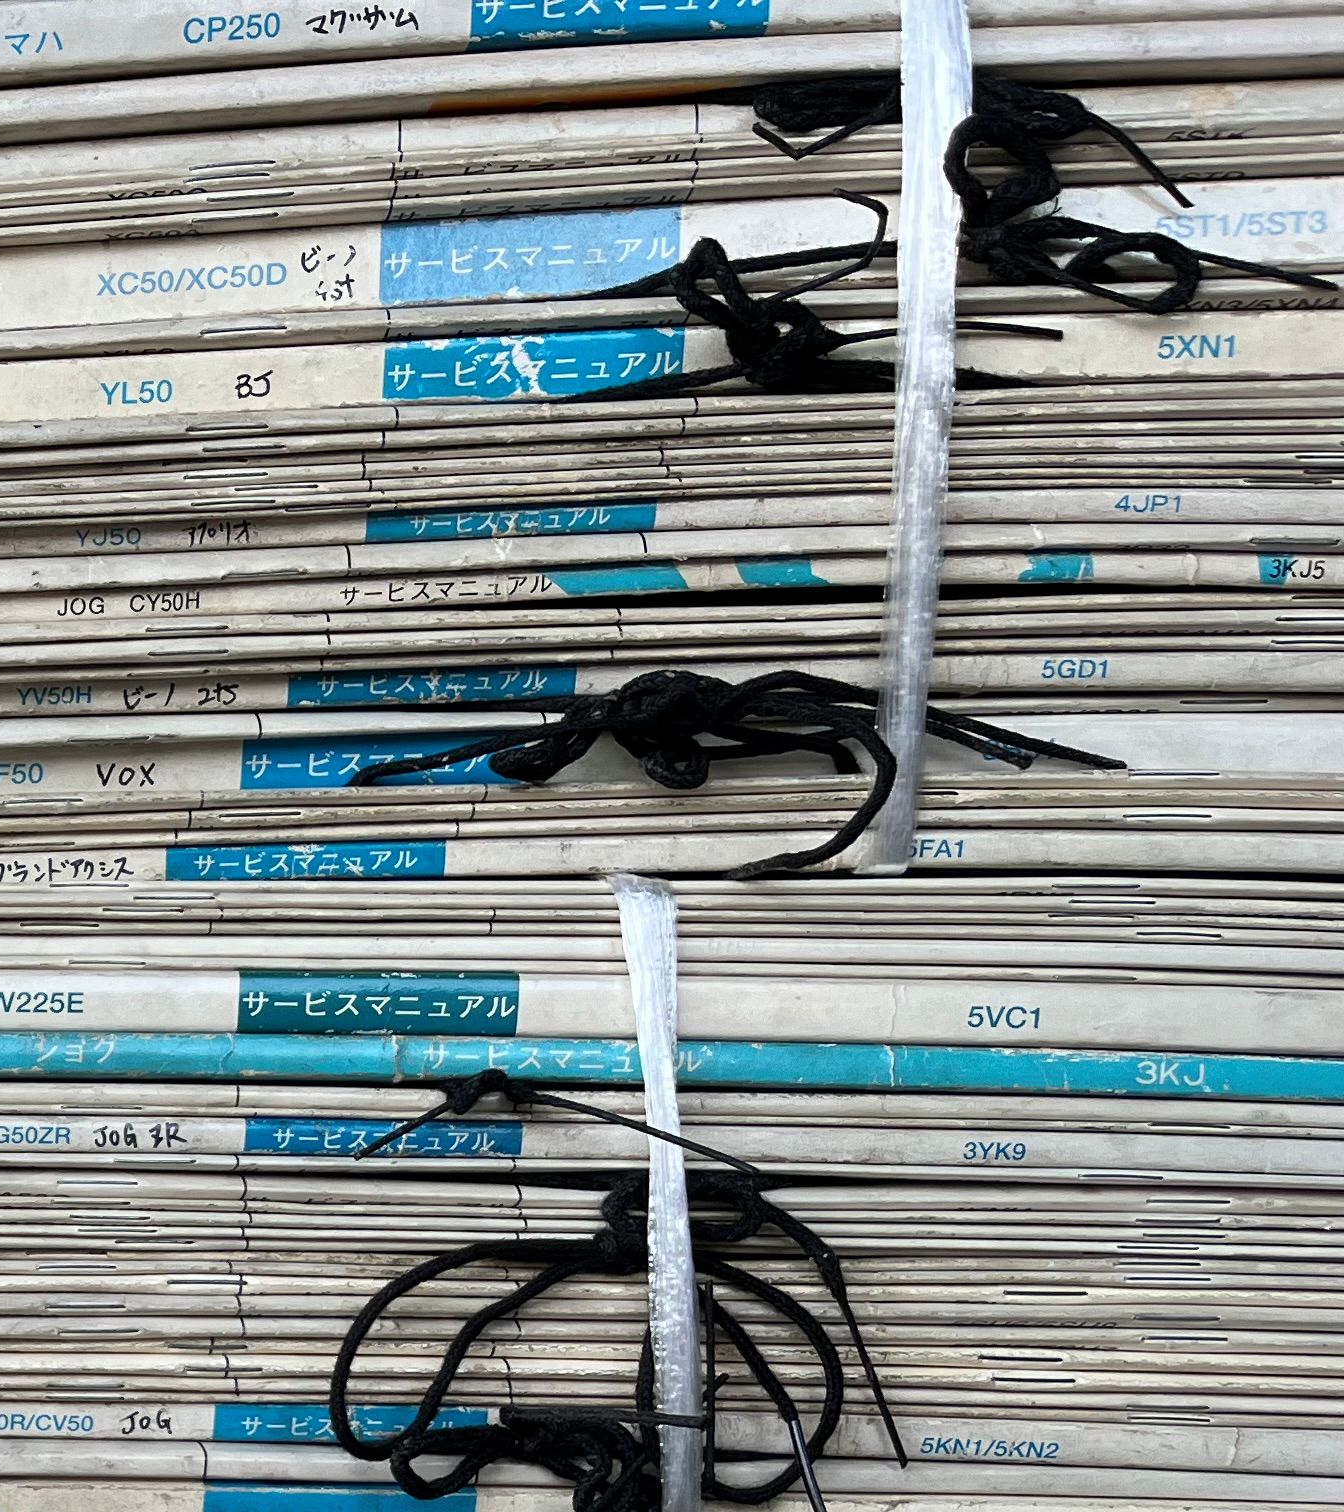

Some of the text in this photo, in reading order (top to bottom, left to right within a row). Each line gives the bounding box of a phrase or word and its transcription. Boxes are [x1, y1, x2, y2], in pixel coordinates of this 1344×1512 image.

[183, 14, 281, 44] CP250
[385, 235, 676, 277] サービスマニュアル
[97, 263, 287, 296] XC50/XC50D
[1158, 335, 1237, 360] 5XN1
[101, 380, 173, 404] YL50
[1115, 496, 1183, 512] 4JP1
[57, 597, 105, 616] JOG
[129, 592, 201, 612] CY50H
[1042, 659, 1109, 679] 5GD1
[17, 686, 93, 705] YV50H
[242, 991, 516, 1019] サービスマニュアル
[967, 1006, 1042, 1029] 5VC1
[1135, 1061, 1206, 1087] 3KJ
[963, 1142, 1027, 1162] 3YK9
